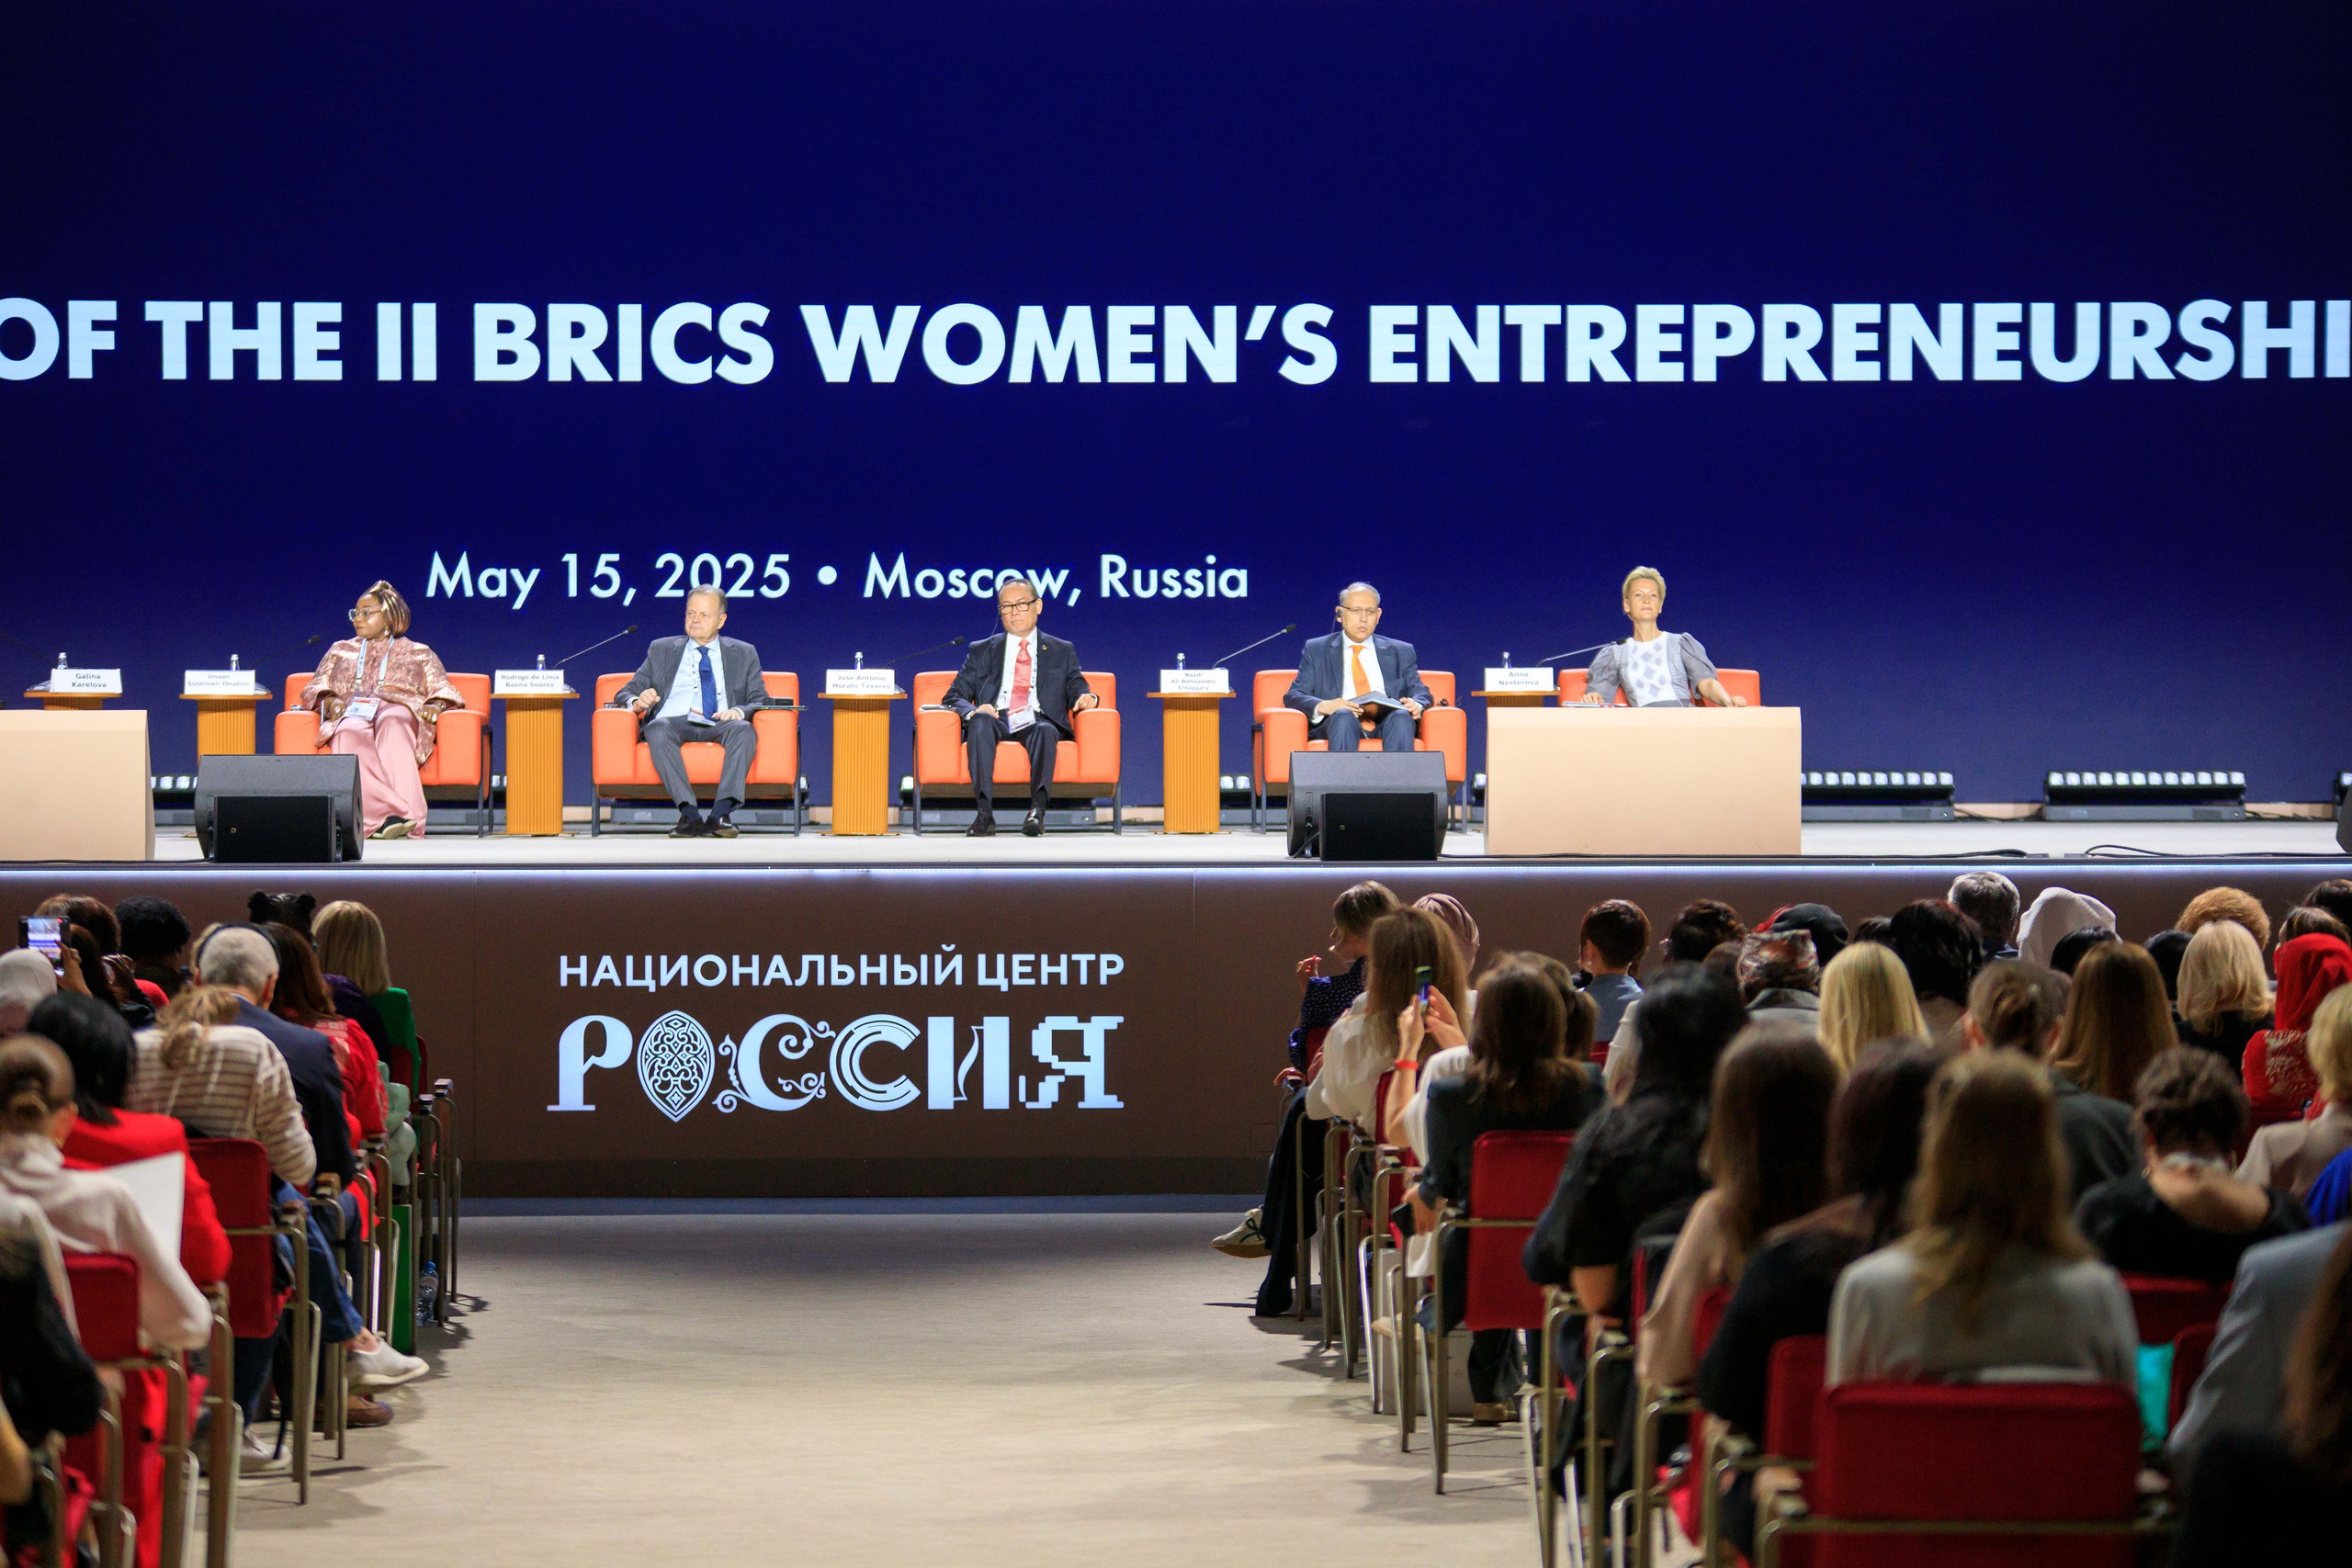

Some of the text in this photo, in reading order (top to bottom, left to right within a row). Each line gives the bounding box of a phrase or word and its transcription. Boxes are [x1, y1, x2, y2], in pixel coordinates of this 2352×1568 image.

[0, 297, 2352, 386] OF THE II BRICS WOMEN’S ENTREPRENEURSHI
[425, 550, 1249, 610] May 15, 2025 Moscow, Russia
[560, 944, 1125, 993] НАЦИОНАЛЬНЫЙ ЦЕНТР
[547, 1010, 1125, 1122] РОССИЯ
